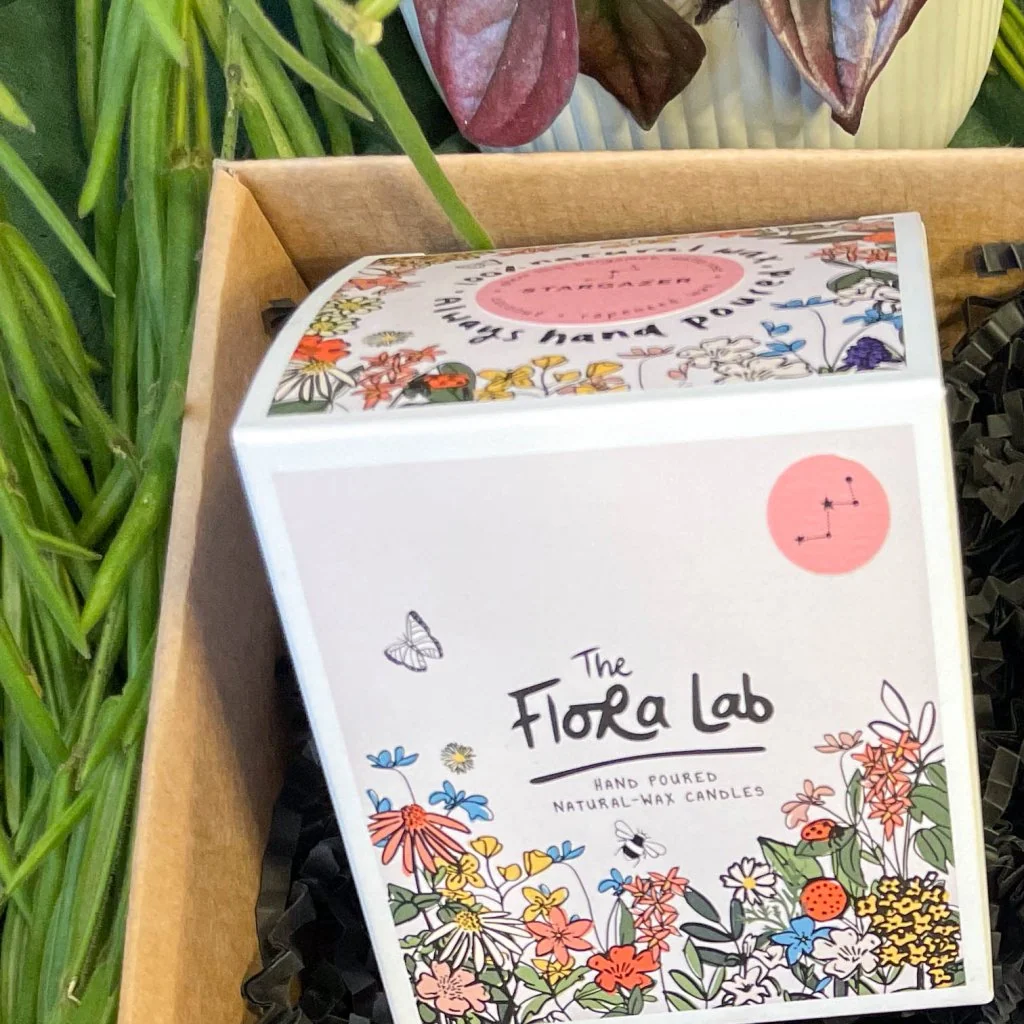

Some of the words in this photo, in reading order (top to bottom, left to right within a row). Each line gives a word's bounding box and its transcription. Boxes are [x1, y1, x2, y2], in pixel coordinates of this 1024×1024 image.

[521, 276, 691, 294] STARGAZER
[433, 296, 524, 345] Always
[539, 324, 668, 345] hand
[681, 268, 795, 330] poured
[570, 646, 633, 678] The
[692, 672, 775, 733] Lab
[594, 777, 639, 793] HAND
[649, 771, 718, 788] POURED
[552, 792, 676, 814] NATURAL-WAX
[685, 785, 766, 803] CANDLES
